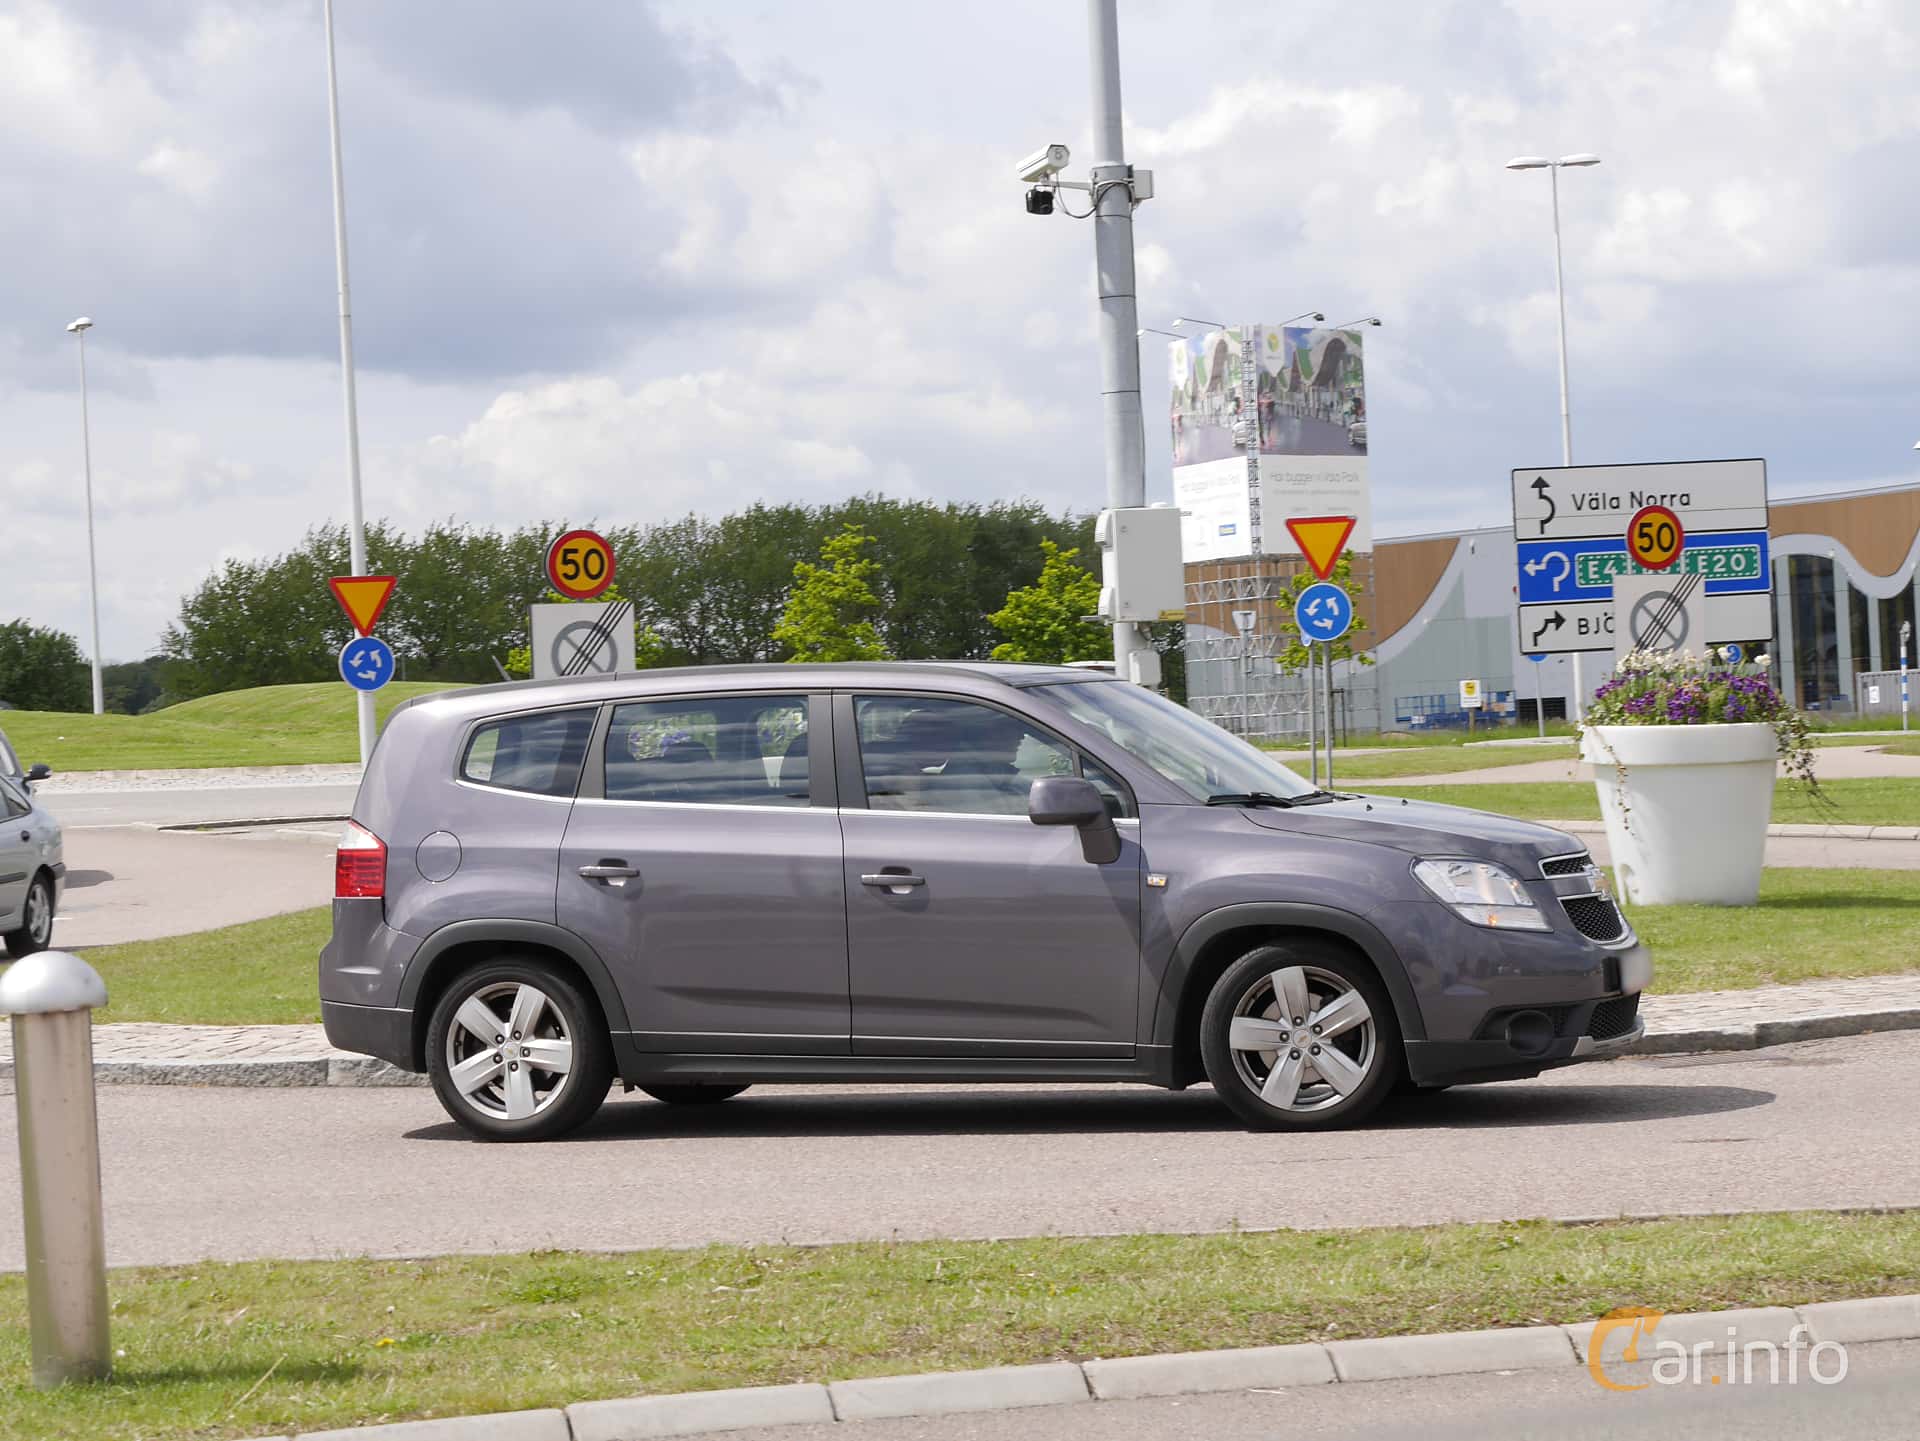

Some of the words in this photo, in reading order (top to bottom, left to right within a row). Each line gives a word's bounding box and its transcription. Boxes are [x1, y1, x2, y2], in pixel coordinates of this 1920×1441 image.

[1571, 491, 1620, 511] Väla
[1629, 491, 1690, 508] Norra
[1638, 522, 1675, 552] 50
[561, 548, 605, 580] 50
[1588, 560, 1617, 579] E4
[1697, 553, 1746, 573] E20
